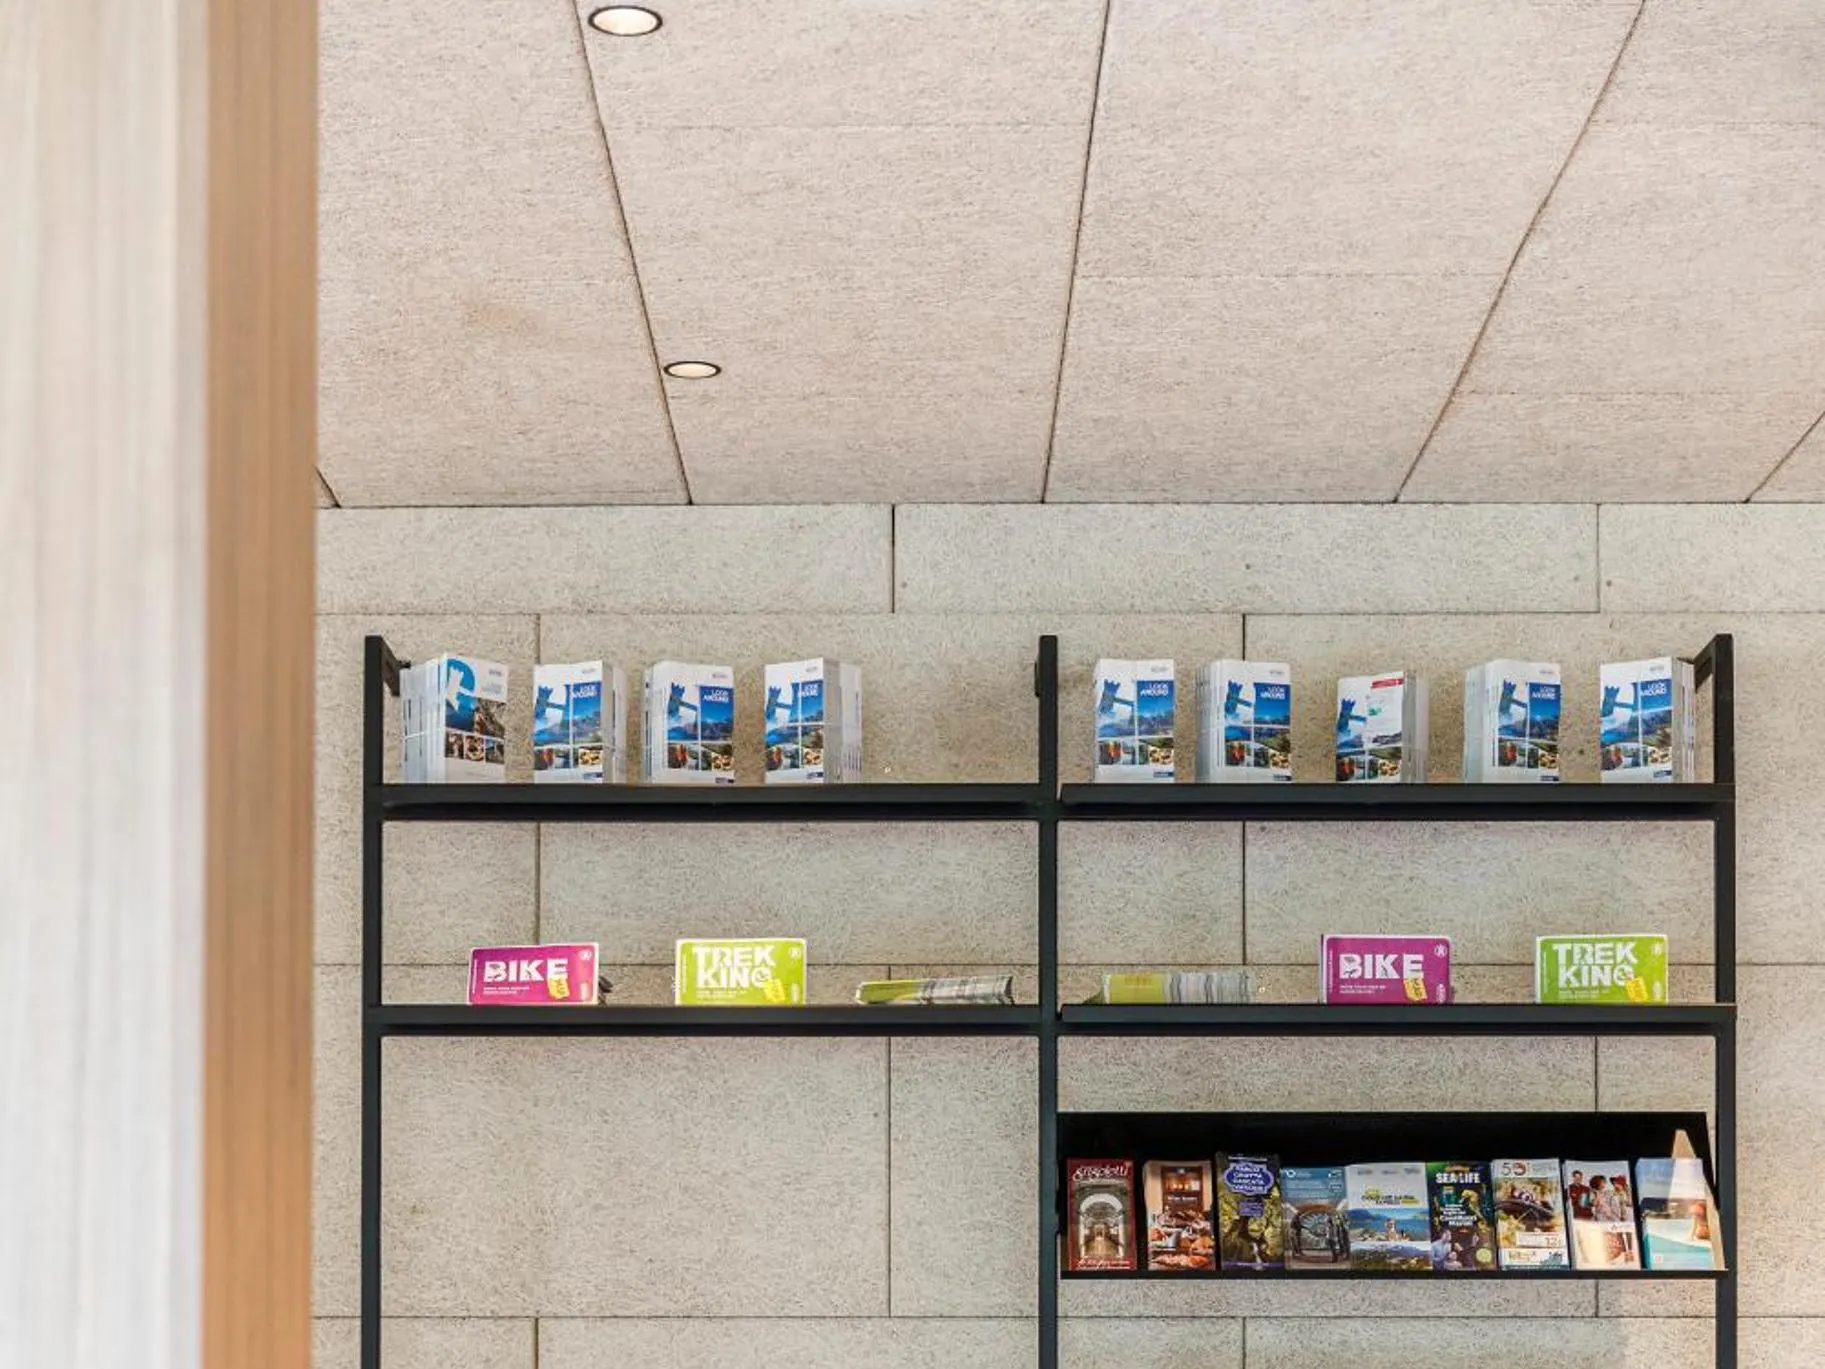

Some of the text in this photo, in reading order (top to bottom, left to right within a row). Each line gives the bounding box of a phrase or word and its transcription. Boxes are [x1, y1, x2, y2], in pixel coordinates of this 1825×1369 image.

[692, 945, 776, 968] TREK
[1552, 942, 1639, 965] TREK
[484, 958, 569, 982] BIKE
[697, 966, 772, 988] KING
[1339, 953, 1424, 979] BIKE
[1559, 964, 1635, 987] KING
[1436, 1172, 1481, 1184] SEA LIFE
